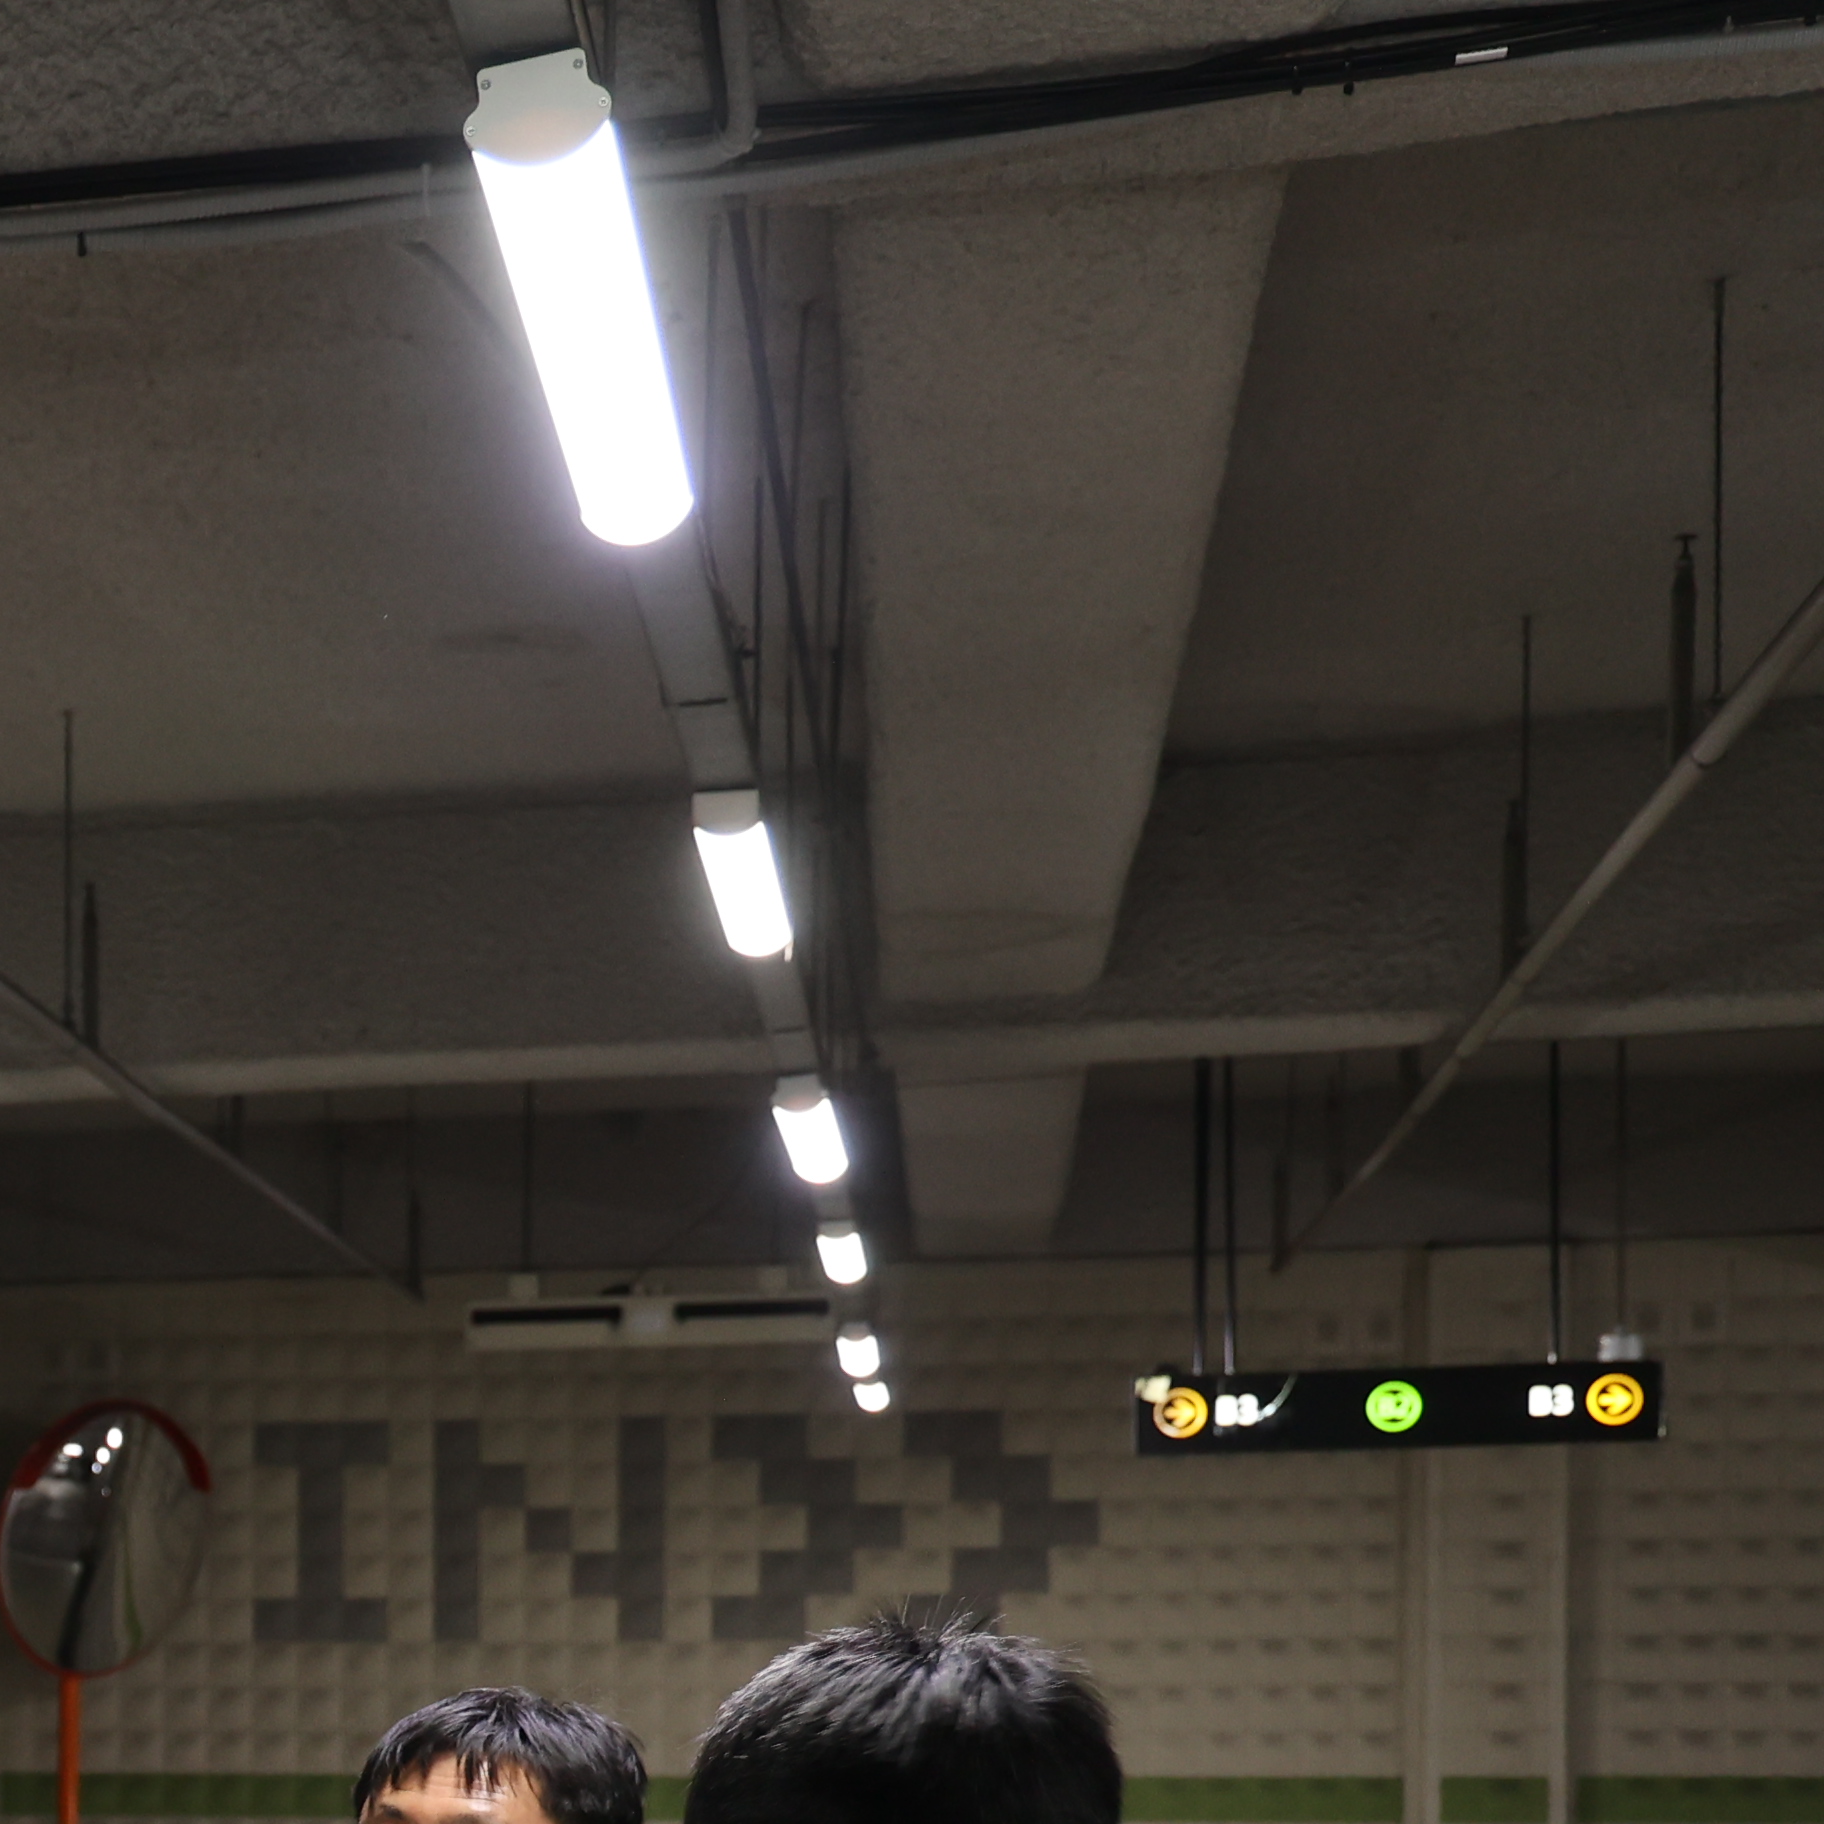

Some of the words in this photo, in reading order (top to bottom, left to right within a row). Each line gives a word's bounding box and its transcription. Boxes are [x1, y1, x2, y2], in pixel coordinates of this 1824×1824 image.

[1214, 1393, 1260, 1427] B3
[1527, 1383, 1575, 1418] B3
[253, 1415, 667, 1641] IN
